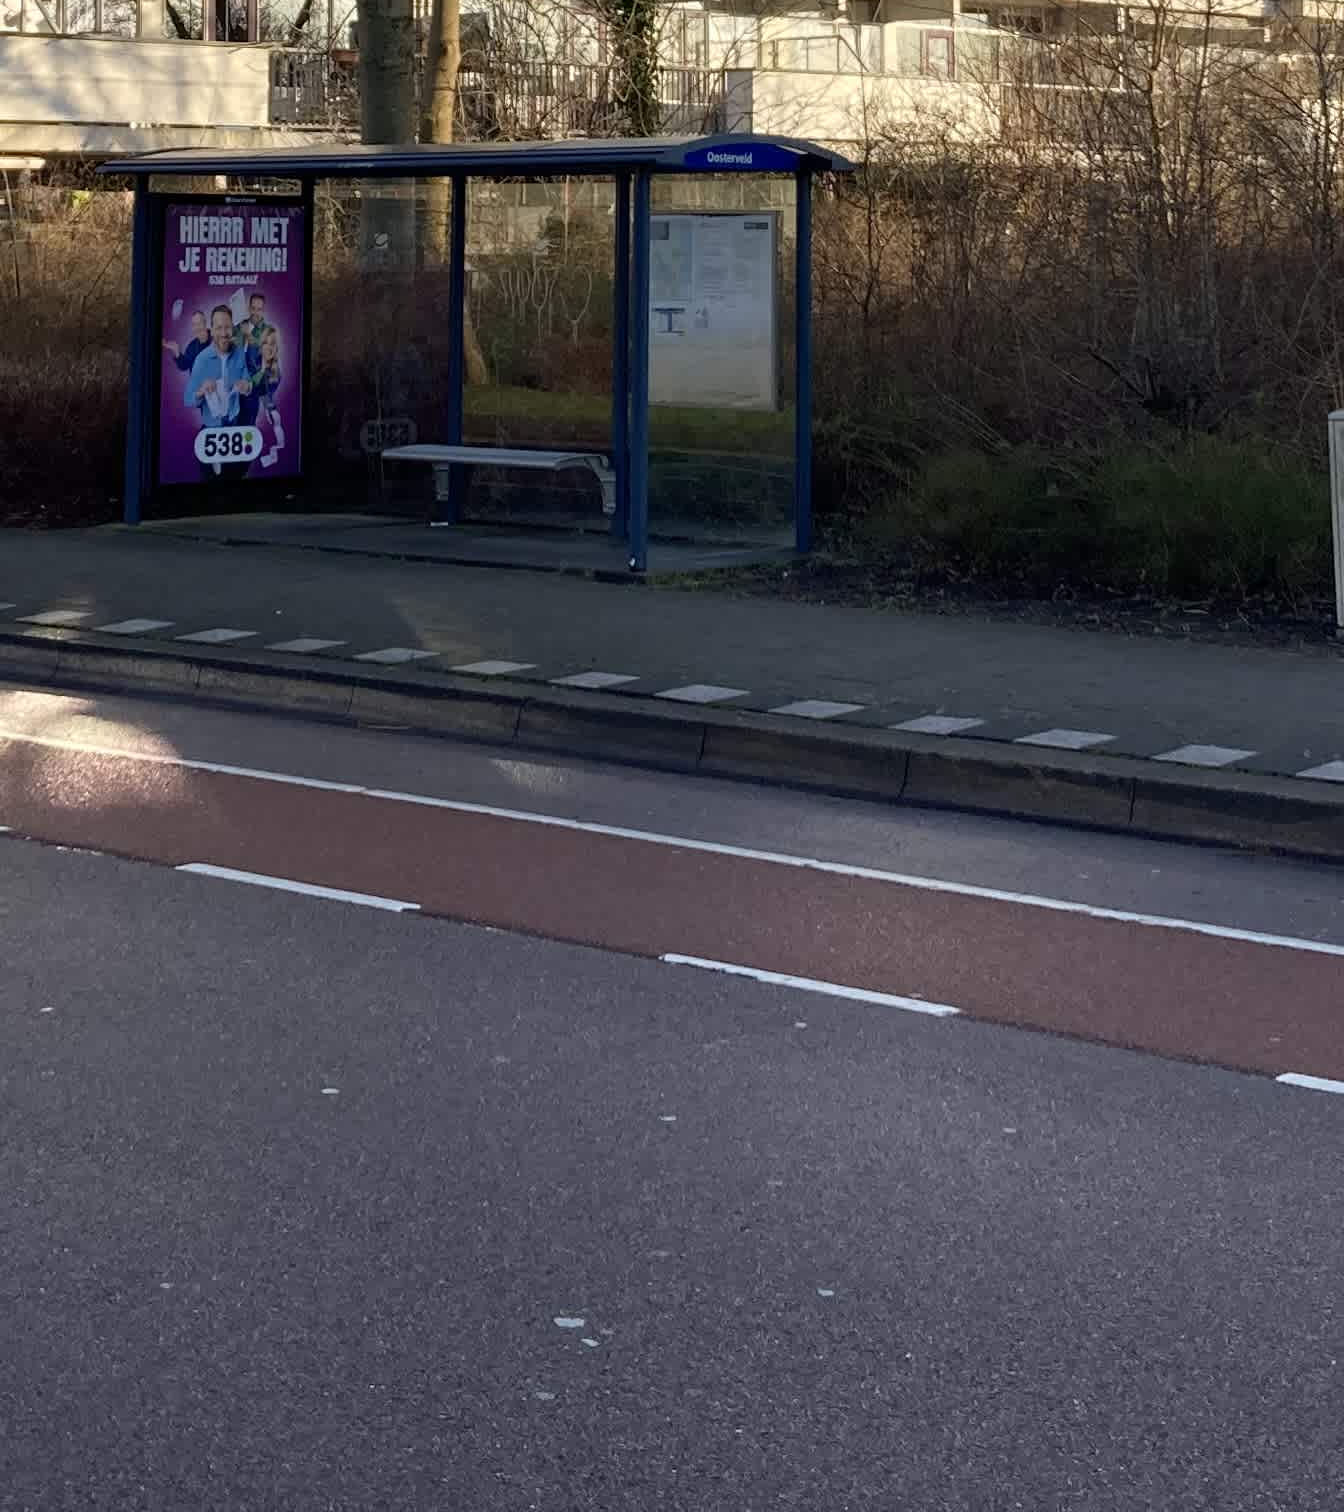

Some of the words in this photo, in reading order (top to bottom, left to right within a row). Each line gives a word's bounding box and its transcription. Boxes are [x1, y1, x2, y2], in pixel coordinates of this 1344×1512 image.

[707, 151, 753, 164] Oosterveld
[179, 215, 244, 244] HIERRR
[250, 216, 289, 244] MET
[178, 246, 201, 273] JE
[205, 247, 288, 273] REKENING!
[204, 431, 243, 457] 538
